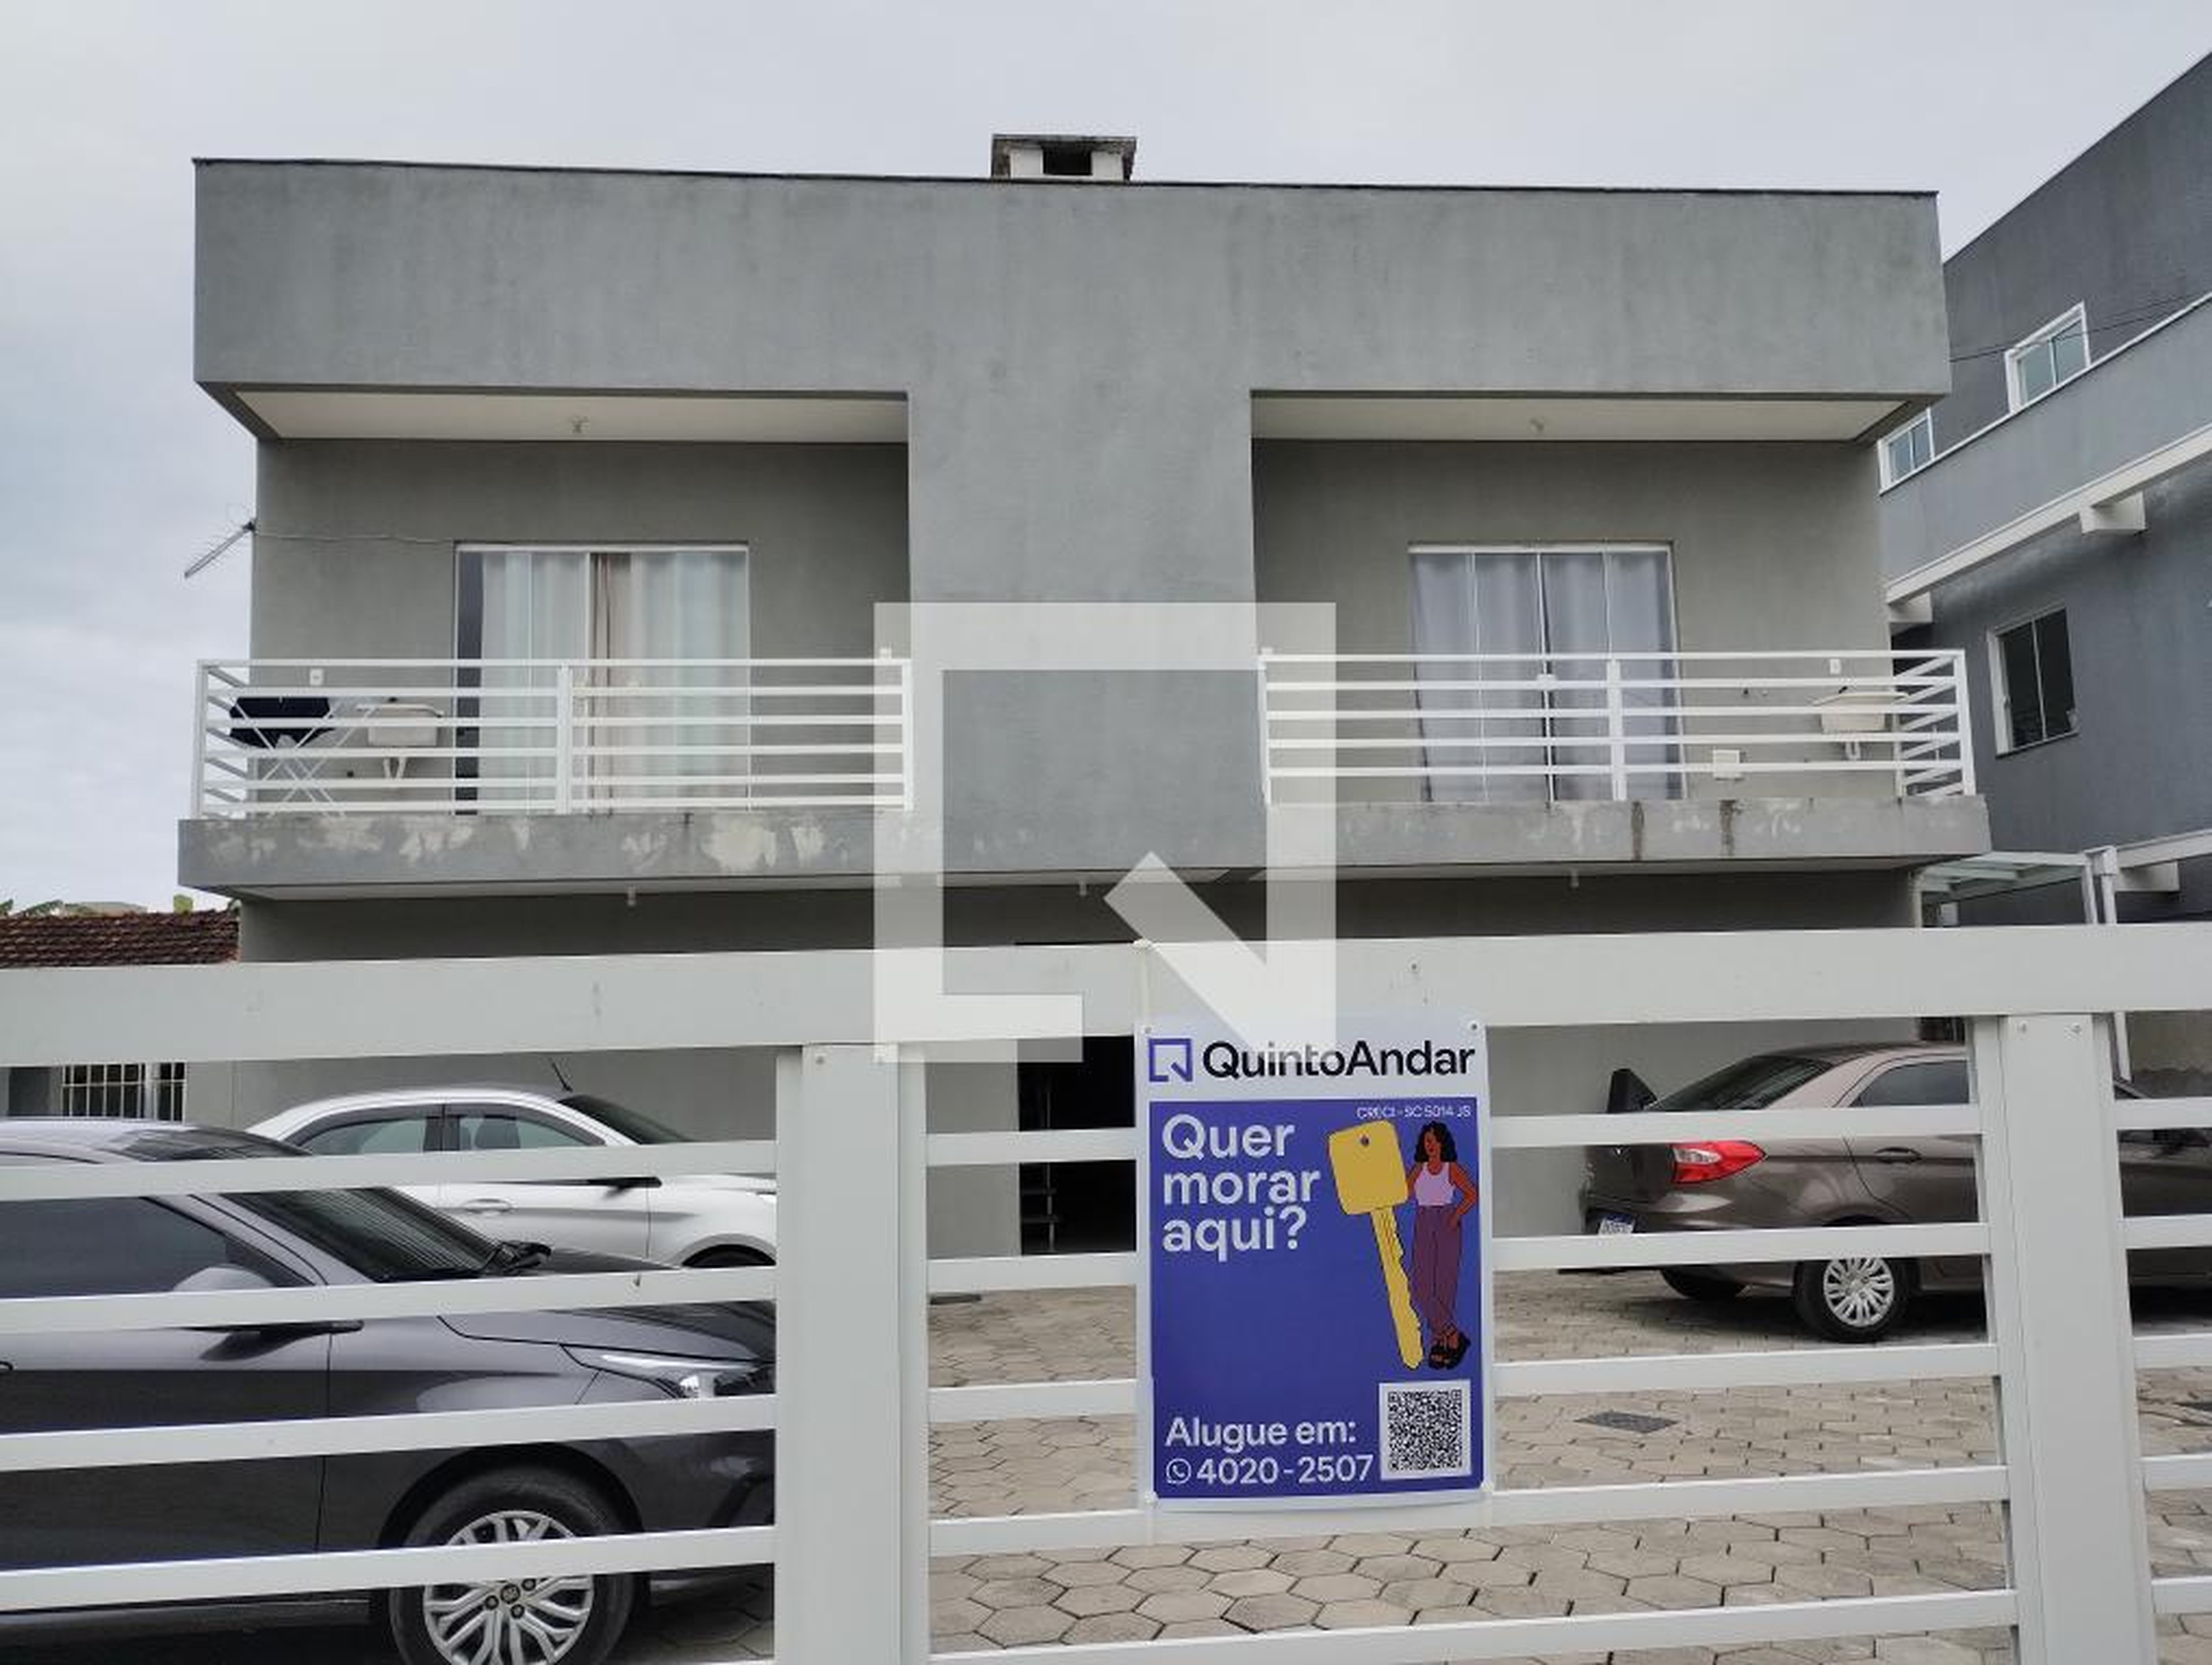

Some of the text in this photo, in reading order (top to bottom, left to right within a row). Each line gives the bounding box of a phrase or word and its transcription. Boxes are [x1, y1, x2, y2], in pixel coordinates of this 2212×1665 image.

[1203, 1041, 1475, 1079] QuintoAndar
[1404, 1105, 1423, 1118] SC
[1456, 1105, 1472, 1117] JS
[1161, 1114, 1296, 1160] Quer
[1163, 1168, 1321, 1205] morar
[1162, 1207, 1307, 1262] aqui?
[1165, 1417, 1357, 1454] Alugue em:
